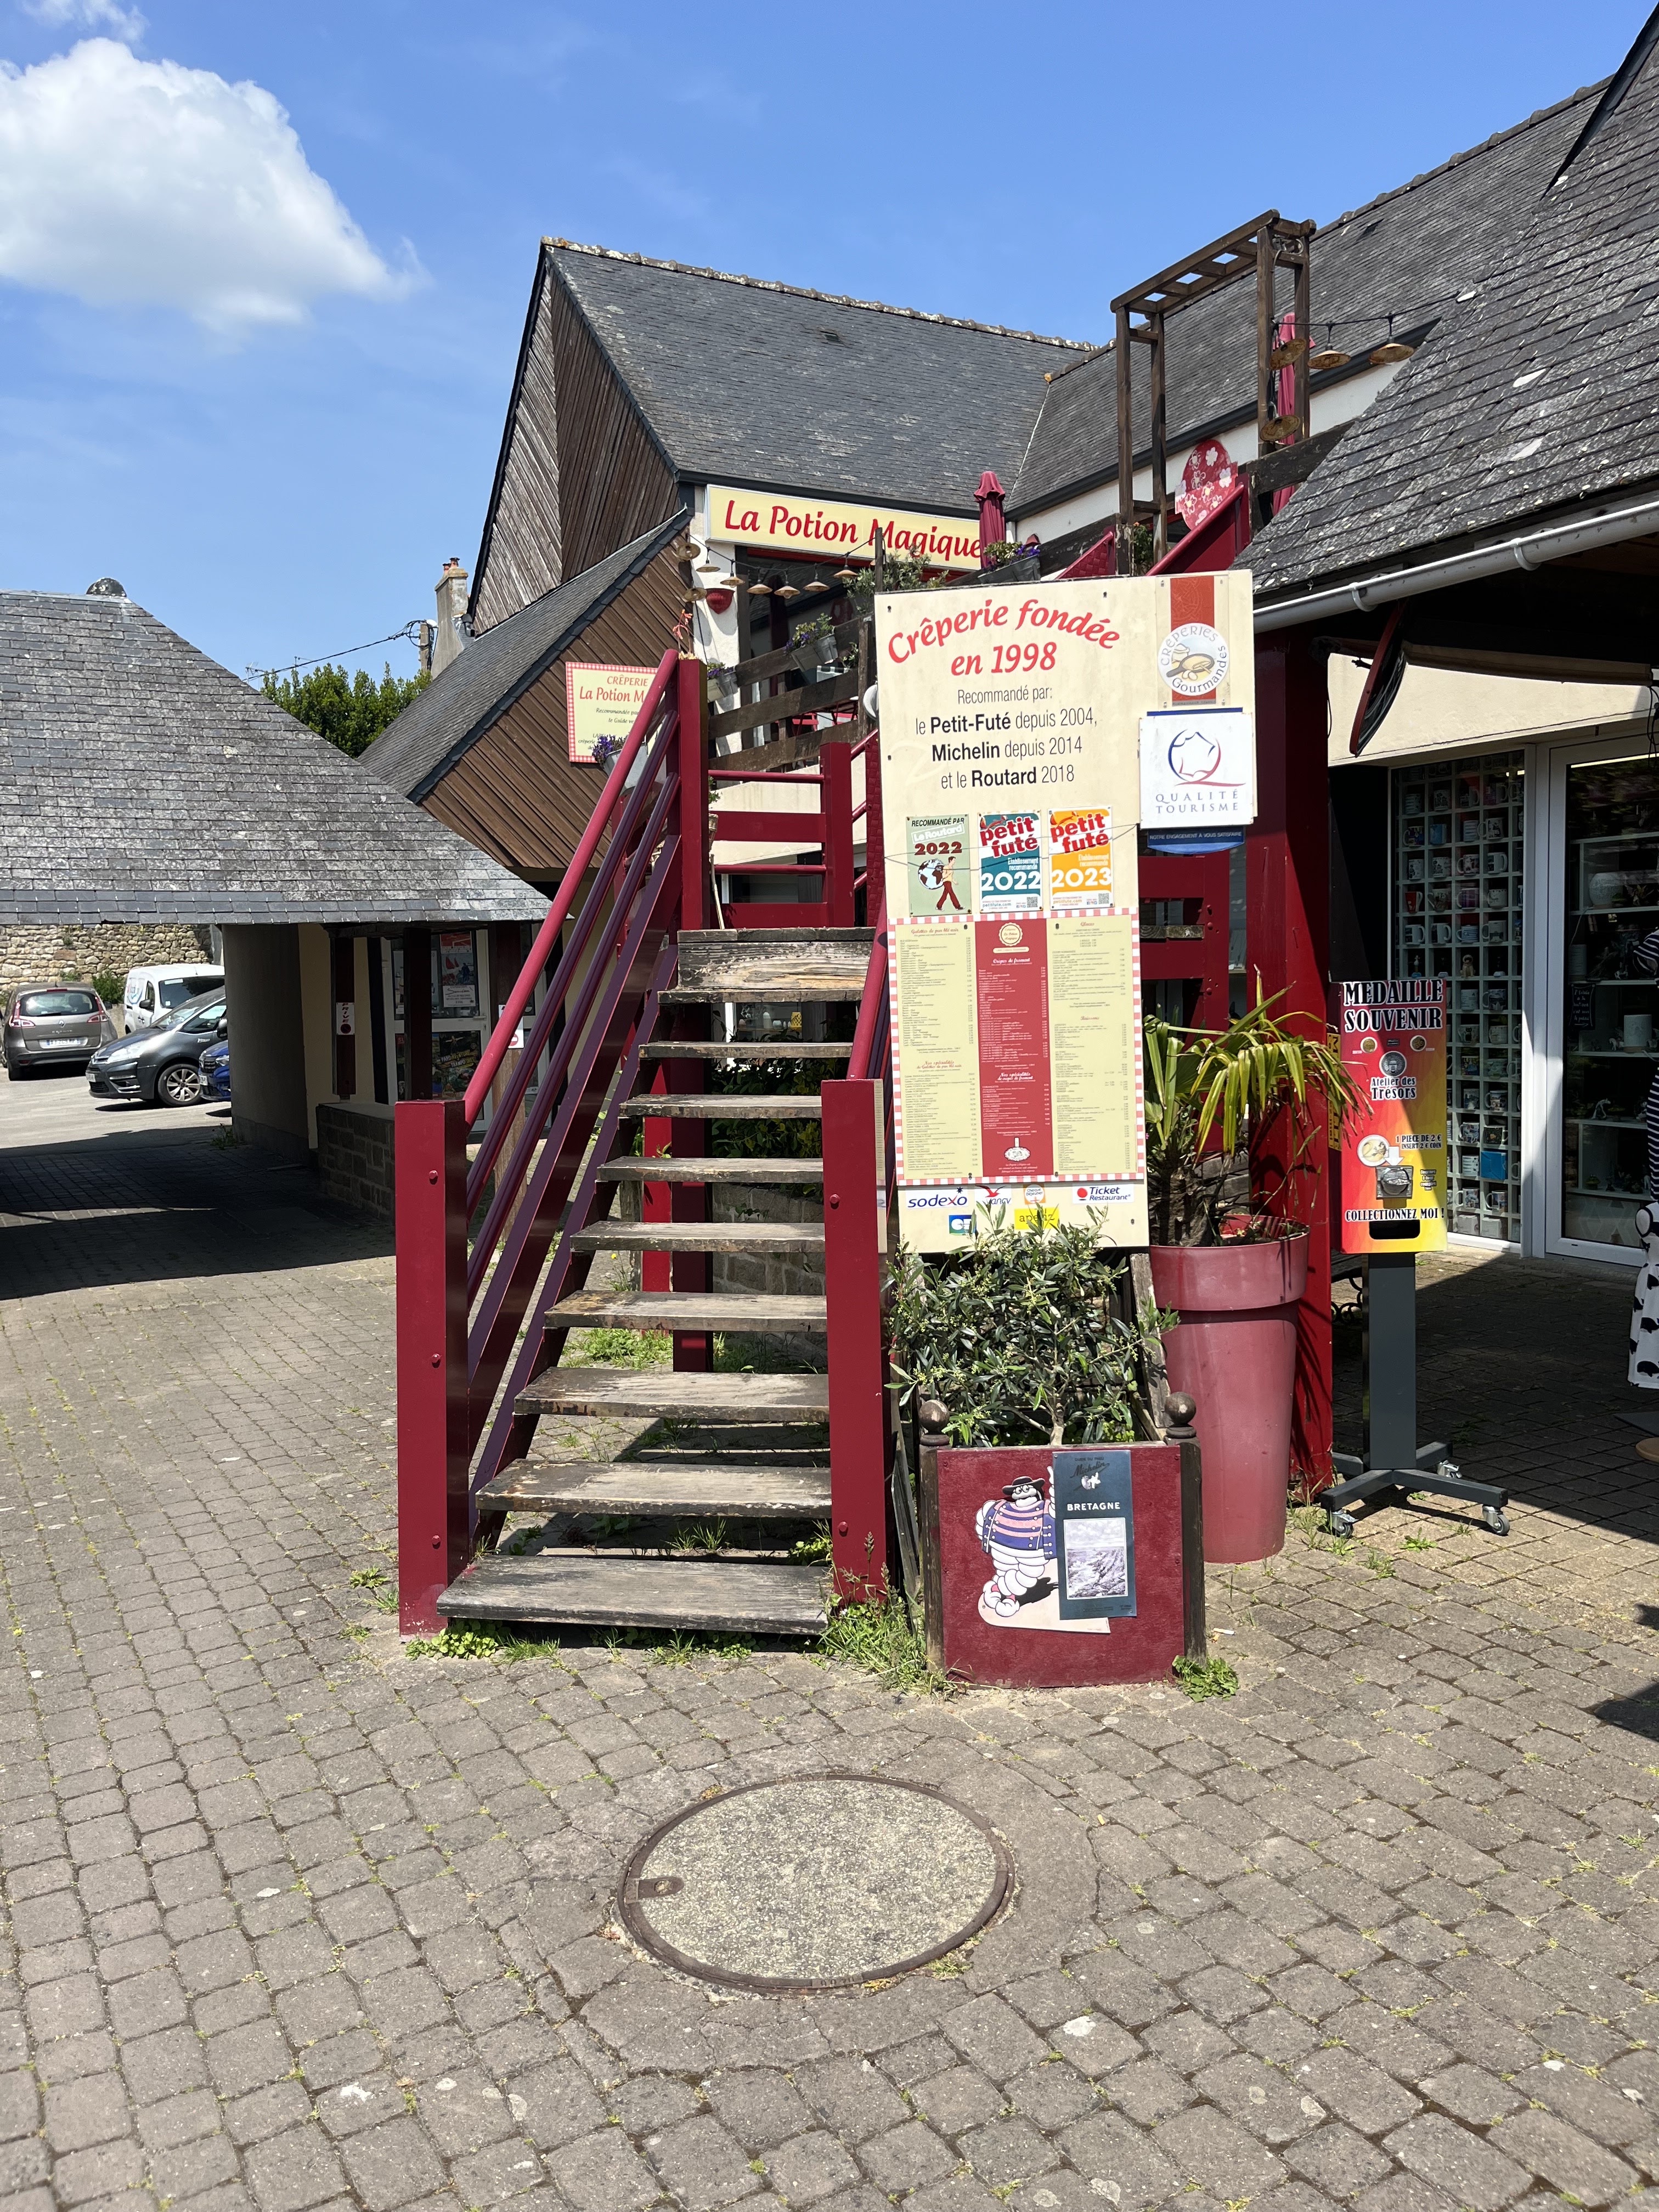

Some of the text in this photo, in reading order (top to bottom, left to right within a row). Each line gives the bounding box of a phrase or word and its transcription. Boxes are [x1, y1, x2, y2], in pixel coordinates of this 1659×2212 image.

[725, 500, 981, 558] La Potion Magique
[888, 599, 1120, 664] Crêperie fondée
[951, 642, 1057, 676] en 1998
[1172, 645, 1227, 693] Gourmandes
[607, 674, 648, 686] CRÊPERIE
[580, 686, 593, 699] La
[596, 687, 631, 702] Potion
[958, 685, 1052, 704] Recommandé par:
[916, 707, 1098, 735] le Petit-Futé depuis 2004,
[932, 736, 1082, 762] Michelin depuis 2014
[941, 765, 1074, 789] et le Routard 2018
[1156, 789, 1238, 804] QUALITÉ
[1156, 803, 1238, 814] TOURISME
[912, 817, 952, 827] RECOMMANDÉ
[980, 816, 1035, 847] petit
[1050, 813, 1105, 843] petit
[913, 824, 963, 842] Le Routard
[1062, 829, 1109, 854] futé
[915, 841, 962, 856] 2022
[991, 833, 1038, 857] futé
[981, 871, 1041, 891] 2022
[1051, 867, 1111, 888] 2023
[1344, 979, 1443, 1006] MEDAILLE
[1345, 1007, 1442, 1031] SOUVENIR
[1372, 1077, 1415, 1087] Atelier des
[1372, 1086, 1416, 1099] Trésors
[907, 1194, 967, 1207] sodexo
[1090, 1187, 1120, 1195] Ticket
[1346, 1209, 1417, 1221] COLLECTIONNEZ
[1420, 1208, 1438, 1218] MOI
[1070, 1461, 1108, 1478] Michelin
[1067, 1502, 1120, 1511] BRETAGNE
